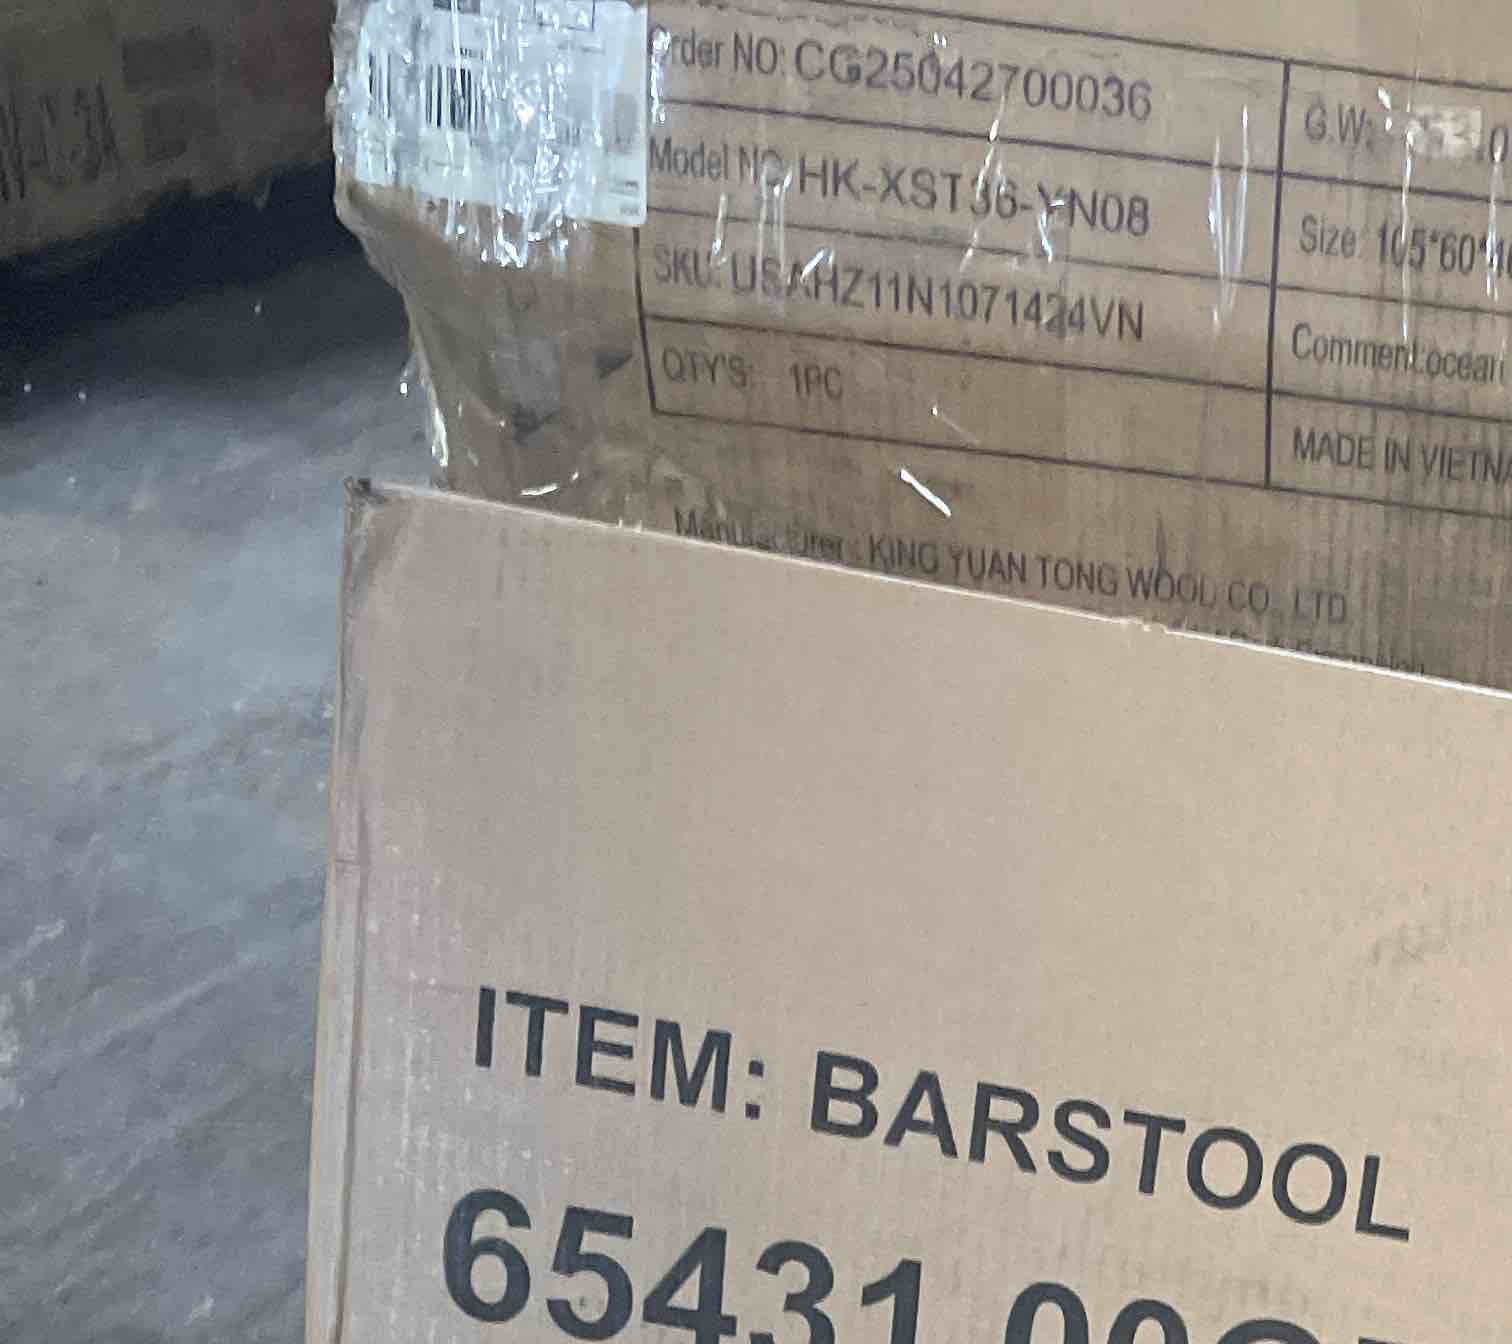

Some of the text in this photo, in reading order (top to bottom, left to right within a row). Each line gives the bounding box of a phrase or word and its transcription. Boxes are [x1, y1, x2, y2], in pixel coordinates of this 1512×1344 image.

[796, 38, 1152, 121] CG25042700036
[650, 136, 729, 180] Model
[789, 363, 843, 400] 1PC
[1292, 426, 1376, 471] MADE
[1384, 435, 1411, 475] IN
[870, 534, 939, 575] KING
[951, 543, 1027, 584] YUAN
[1036, 555, 1119, 597] TONG
[474, 984, 1411, 1244] ITEM: BARSTOOL
